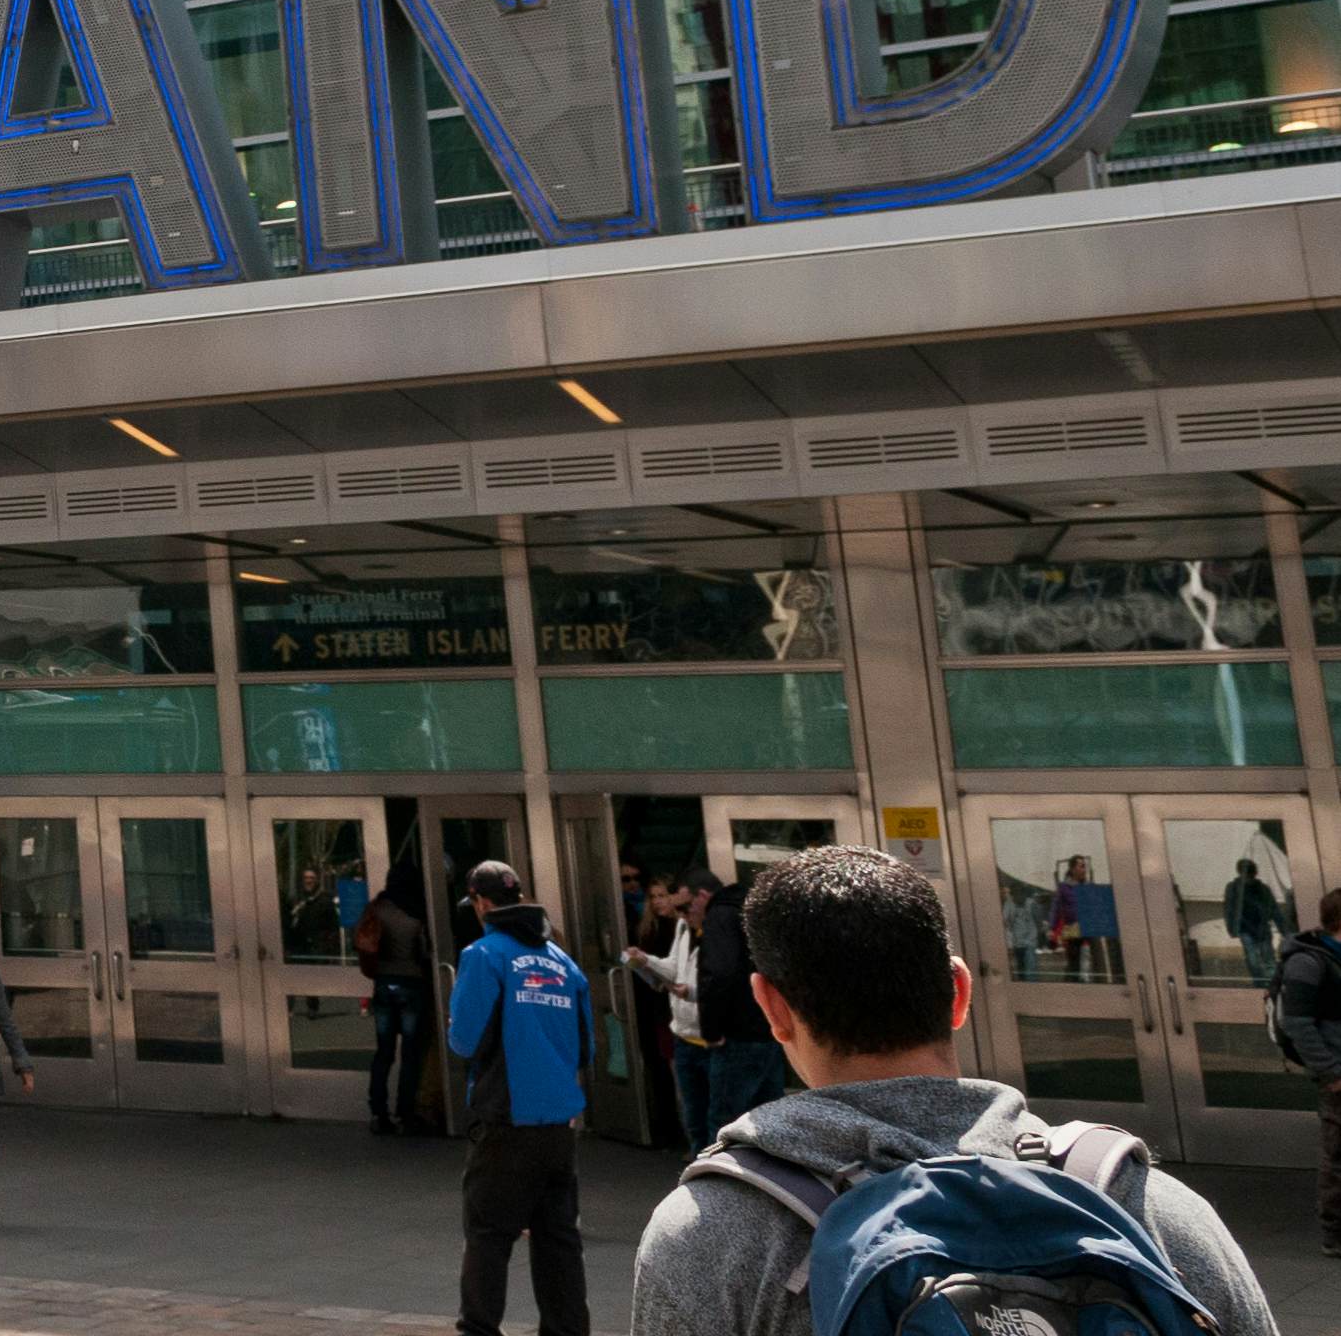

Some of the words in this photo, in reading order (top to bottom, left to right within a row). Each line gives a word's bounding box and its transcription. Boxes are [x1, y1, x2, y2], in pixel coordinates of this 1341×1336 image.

[401, 588, 445, 603] Ferry
[374, 604, 446, 621] Terminal
[314, 629, 411, 659] STATEN
[427, 627, 508, 655] ISLAN
[540, 622, 630, 652] FERRY
[899, 818, 926, 829] AED
[511, 954, 535, 973] NEW
[535, 955, 569, 978] YORK
[989, 1304, 1023, 1322] THE
[974, 1311, 1029, 1336] NORTH
